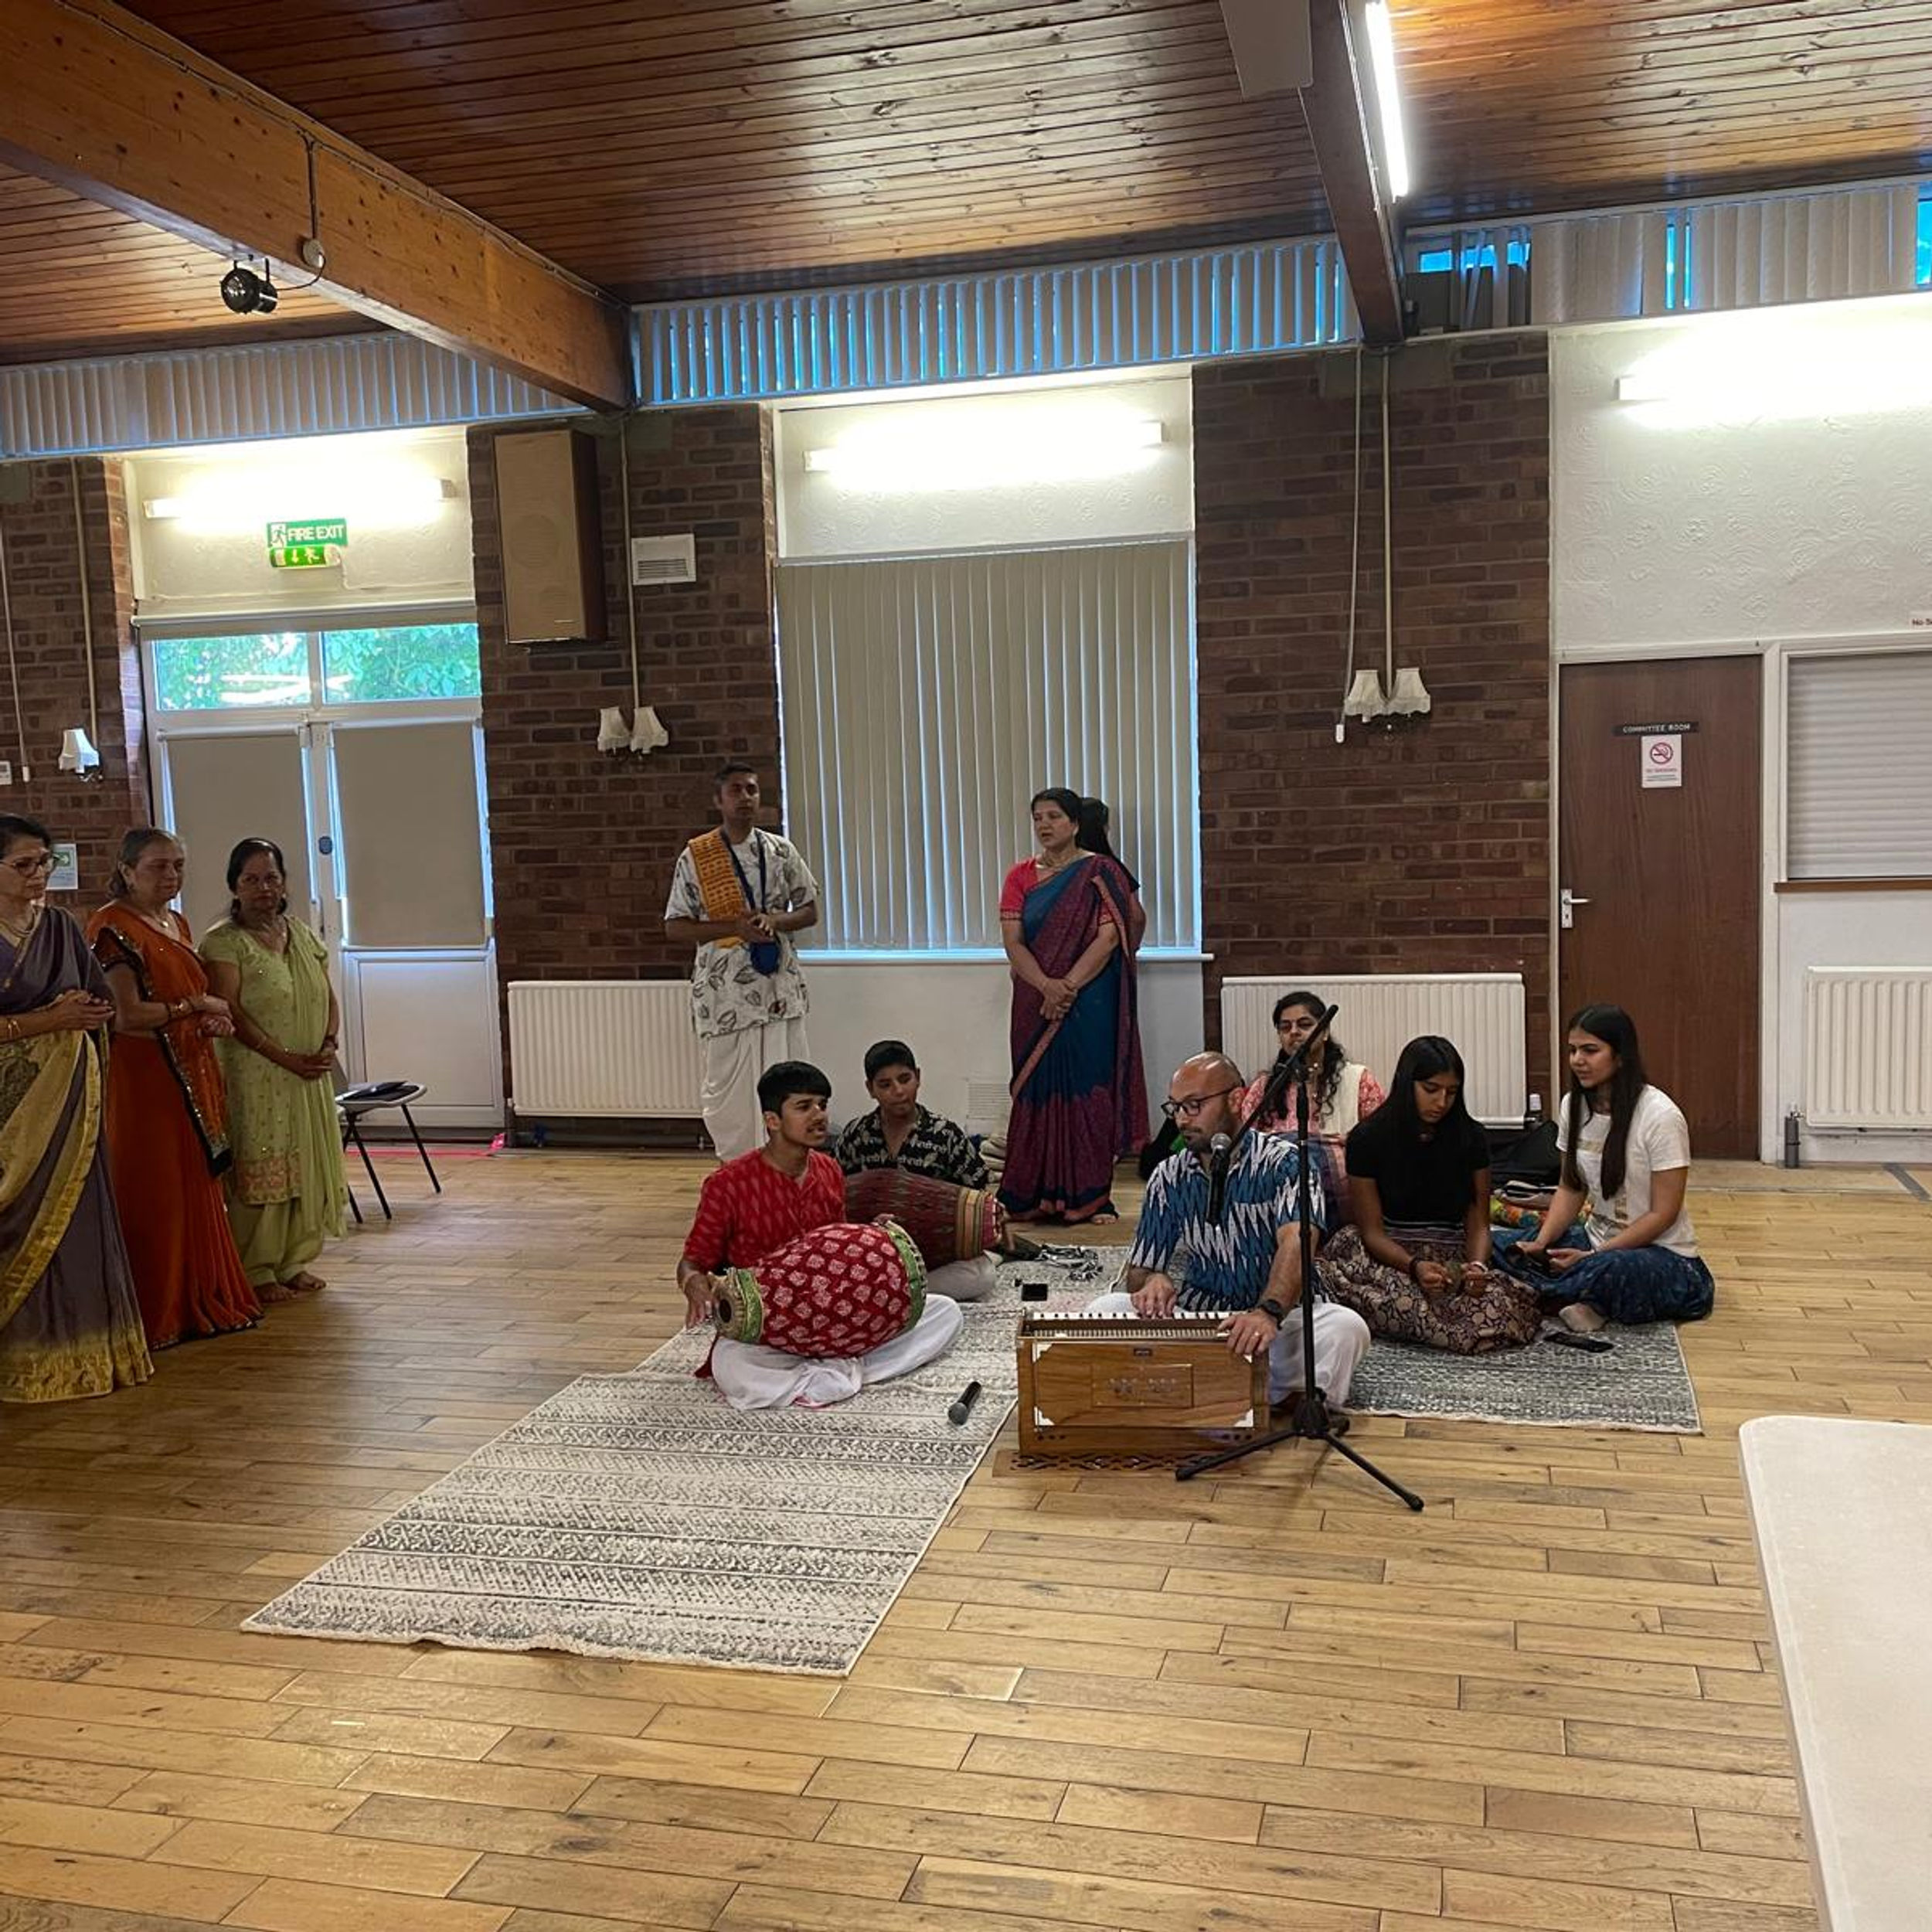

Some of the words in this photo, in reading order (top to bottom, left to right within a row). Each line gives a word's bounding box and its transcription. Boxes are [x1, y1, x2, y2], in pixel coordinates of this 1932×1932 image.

[287, 527, 315, 541] FIRE
[316, 525, 344, 539] EXIT
[1623, 725, 1665, 733] COMMITTEE
